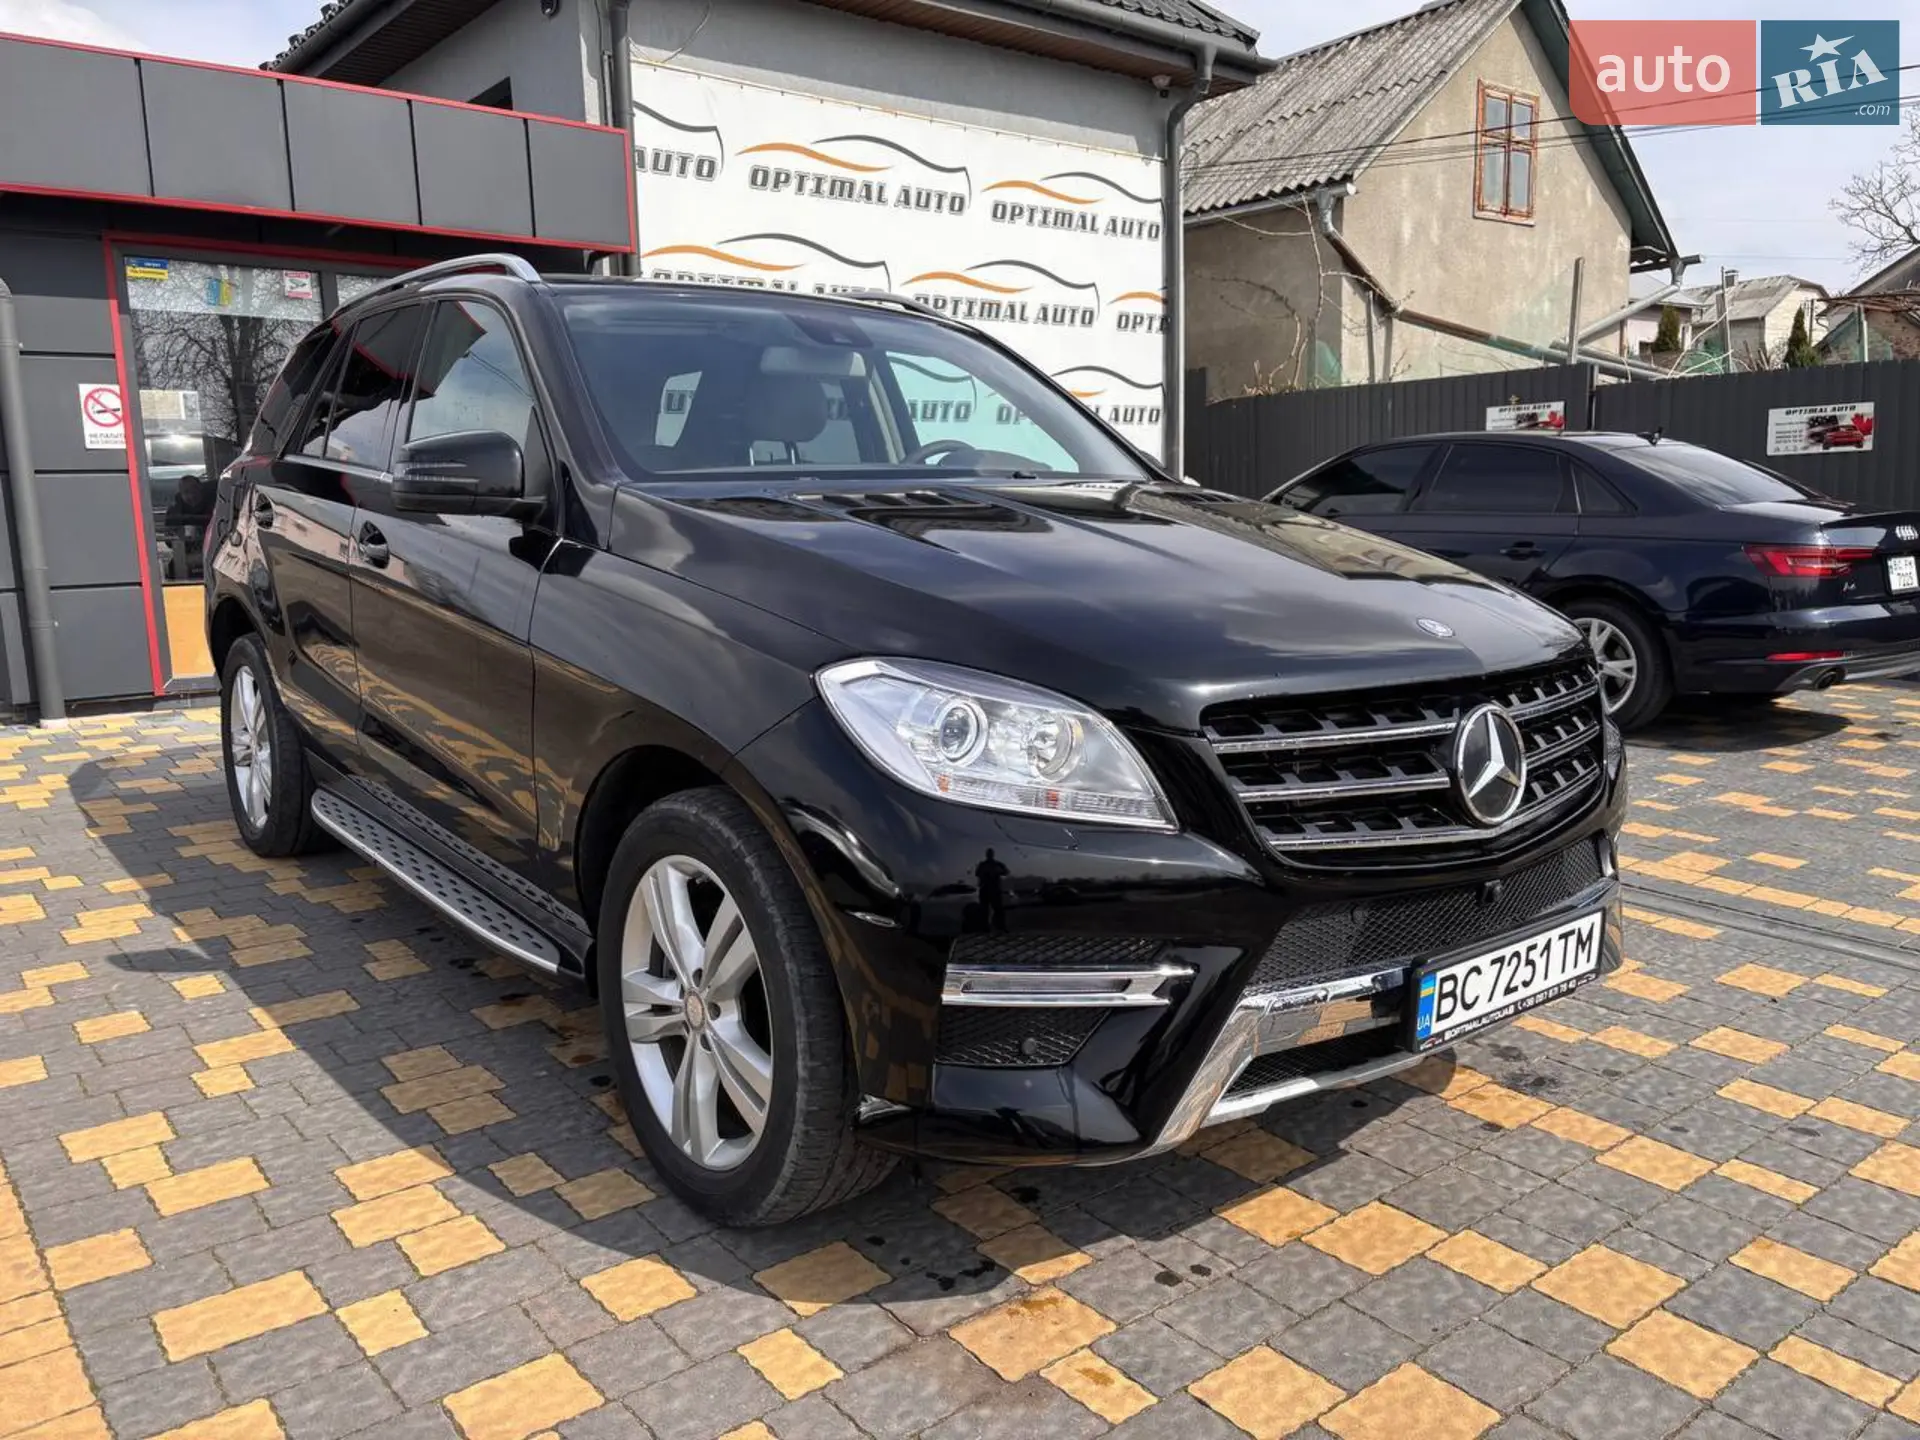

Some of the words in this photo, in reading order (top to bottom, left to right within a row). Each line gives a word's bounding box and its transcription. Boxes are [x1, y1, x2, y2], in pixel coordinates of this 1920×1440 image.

[749, 164, 888, 206] OPTIMAL
[895, 185, 966, 216] AUTO
[991, 200, 1100, 234] OPTIMAL
[1103, 215, 1160, 241] AUTO
[1033, 305, 1095, 328] AUTO
[1107, 403, 1161, 426] AUTO
[1435, 965, 1482, 1023] BC
[1488, 937, 1552, 1003] 7251
[1558, 921, 1595, 974] TM
[1417, 1013, 1431, 1030] UA
